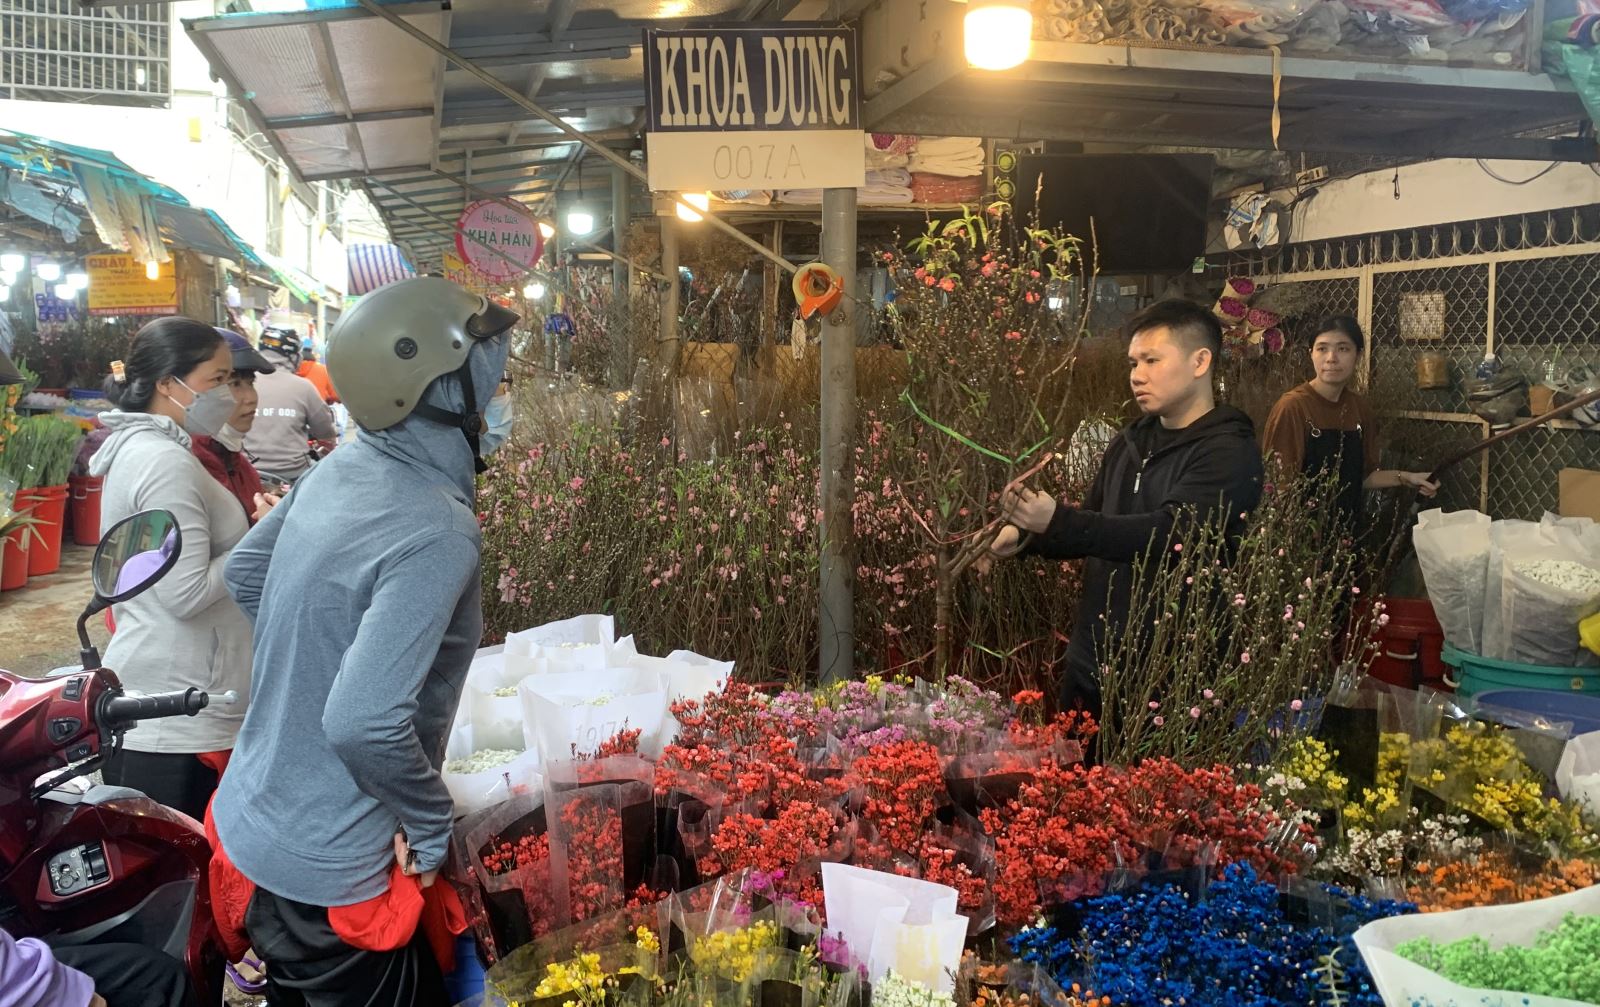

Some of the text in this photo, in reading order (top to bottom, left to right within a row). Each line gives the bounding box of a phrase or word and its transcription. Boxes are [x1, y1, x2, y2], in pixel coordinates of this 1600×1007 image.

[656, 36, 851, 126] KHOA DUNG
[263, 408, 274, 416] OF
